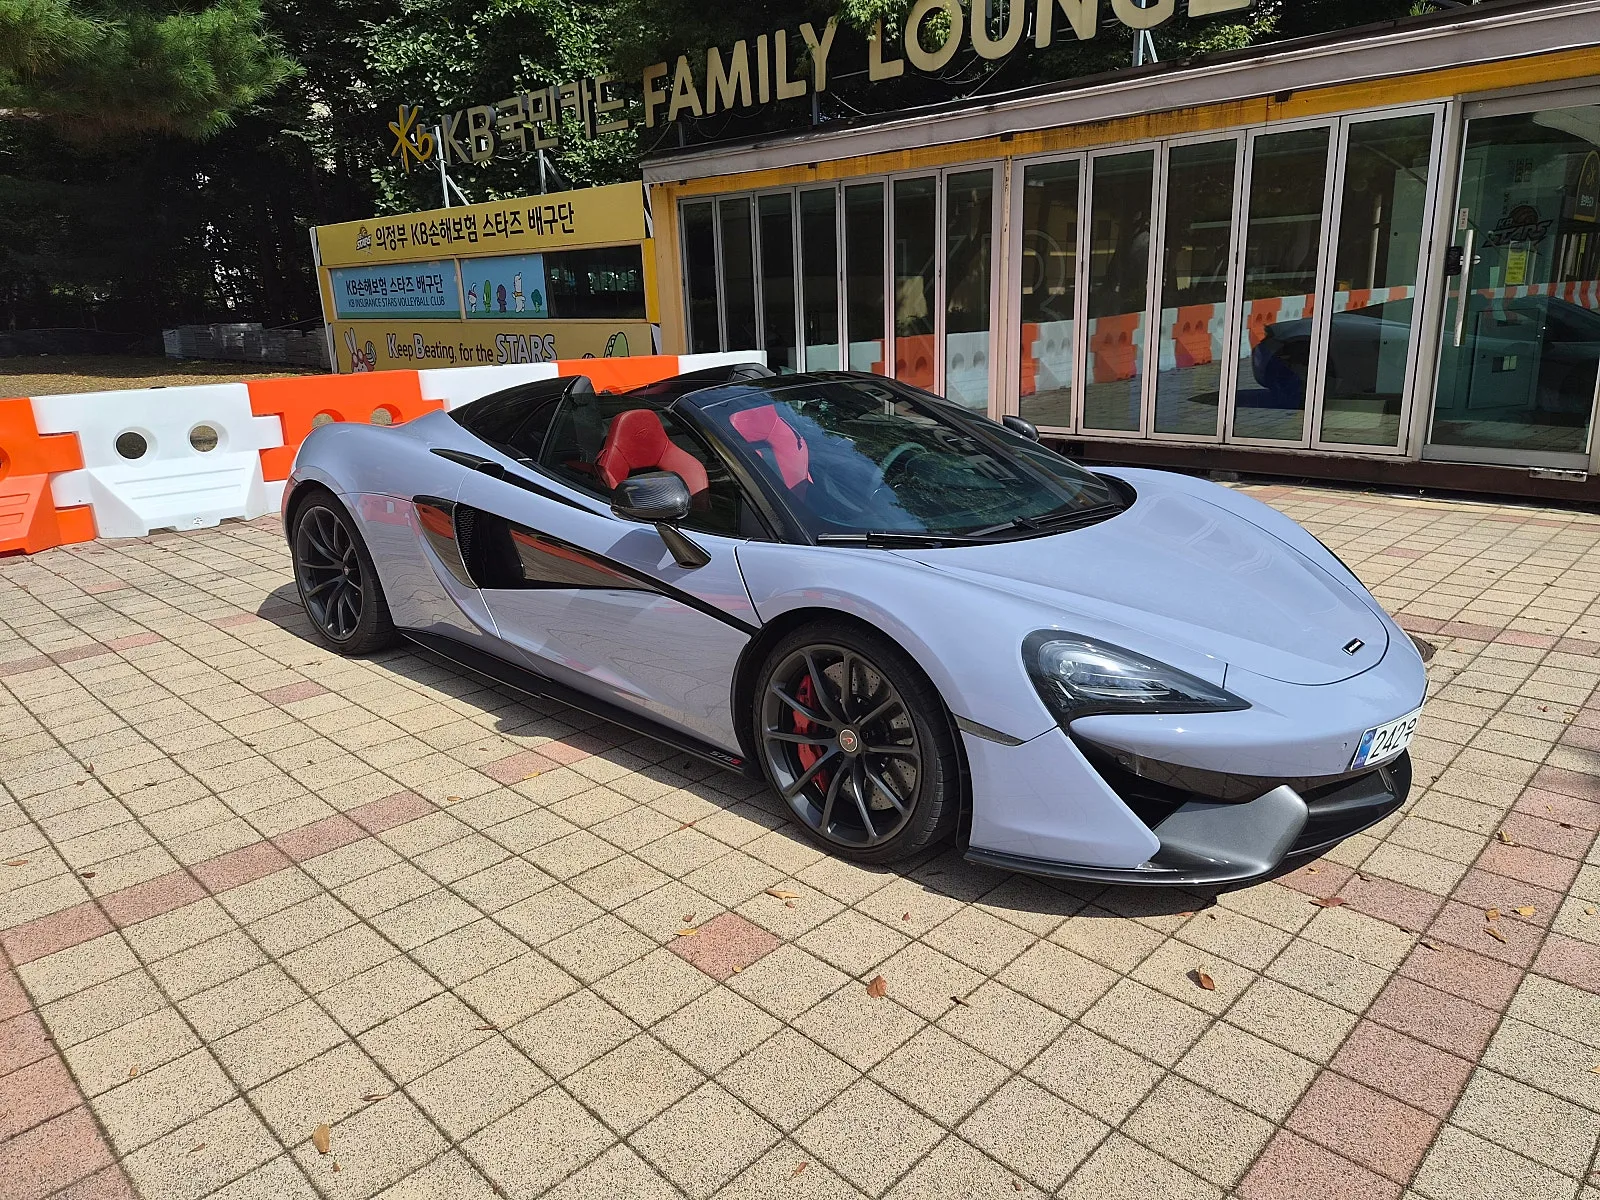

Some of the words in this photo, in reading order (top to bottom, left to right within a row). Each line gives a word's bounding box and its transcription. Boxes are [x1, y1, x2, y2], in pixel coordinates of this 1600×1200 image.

[441, 74, 630, 167] KB국민카드
[642, 18, 838, 129] FAMILY
[375, 223, 408, 251] 의정부
[410, 214, 479, 247] KB손해보험
[482, 210, 524, 239] 스타즈
[527, 201, 575, 236] 배구단
[345, 277, 388, 296] KB손해보험
[390, 275, 415, 294] 스타즈
[416, 273, 444, 294] 배구단
[355, 298, 381, 308] INSURANCE
[382, 298, 398, 308] STARS
[398, 296, 430, 307] VOLLEYBALL
[430, 295, 446, 307] CLUB
[386, 333, 414, 362] Keep
[413, 333, 458, 364] Beating,
[458, 343, 474, 362] for
[475, 343, 494, 363] the
[495, 333, 558, 364] STARS
